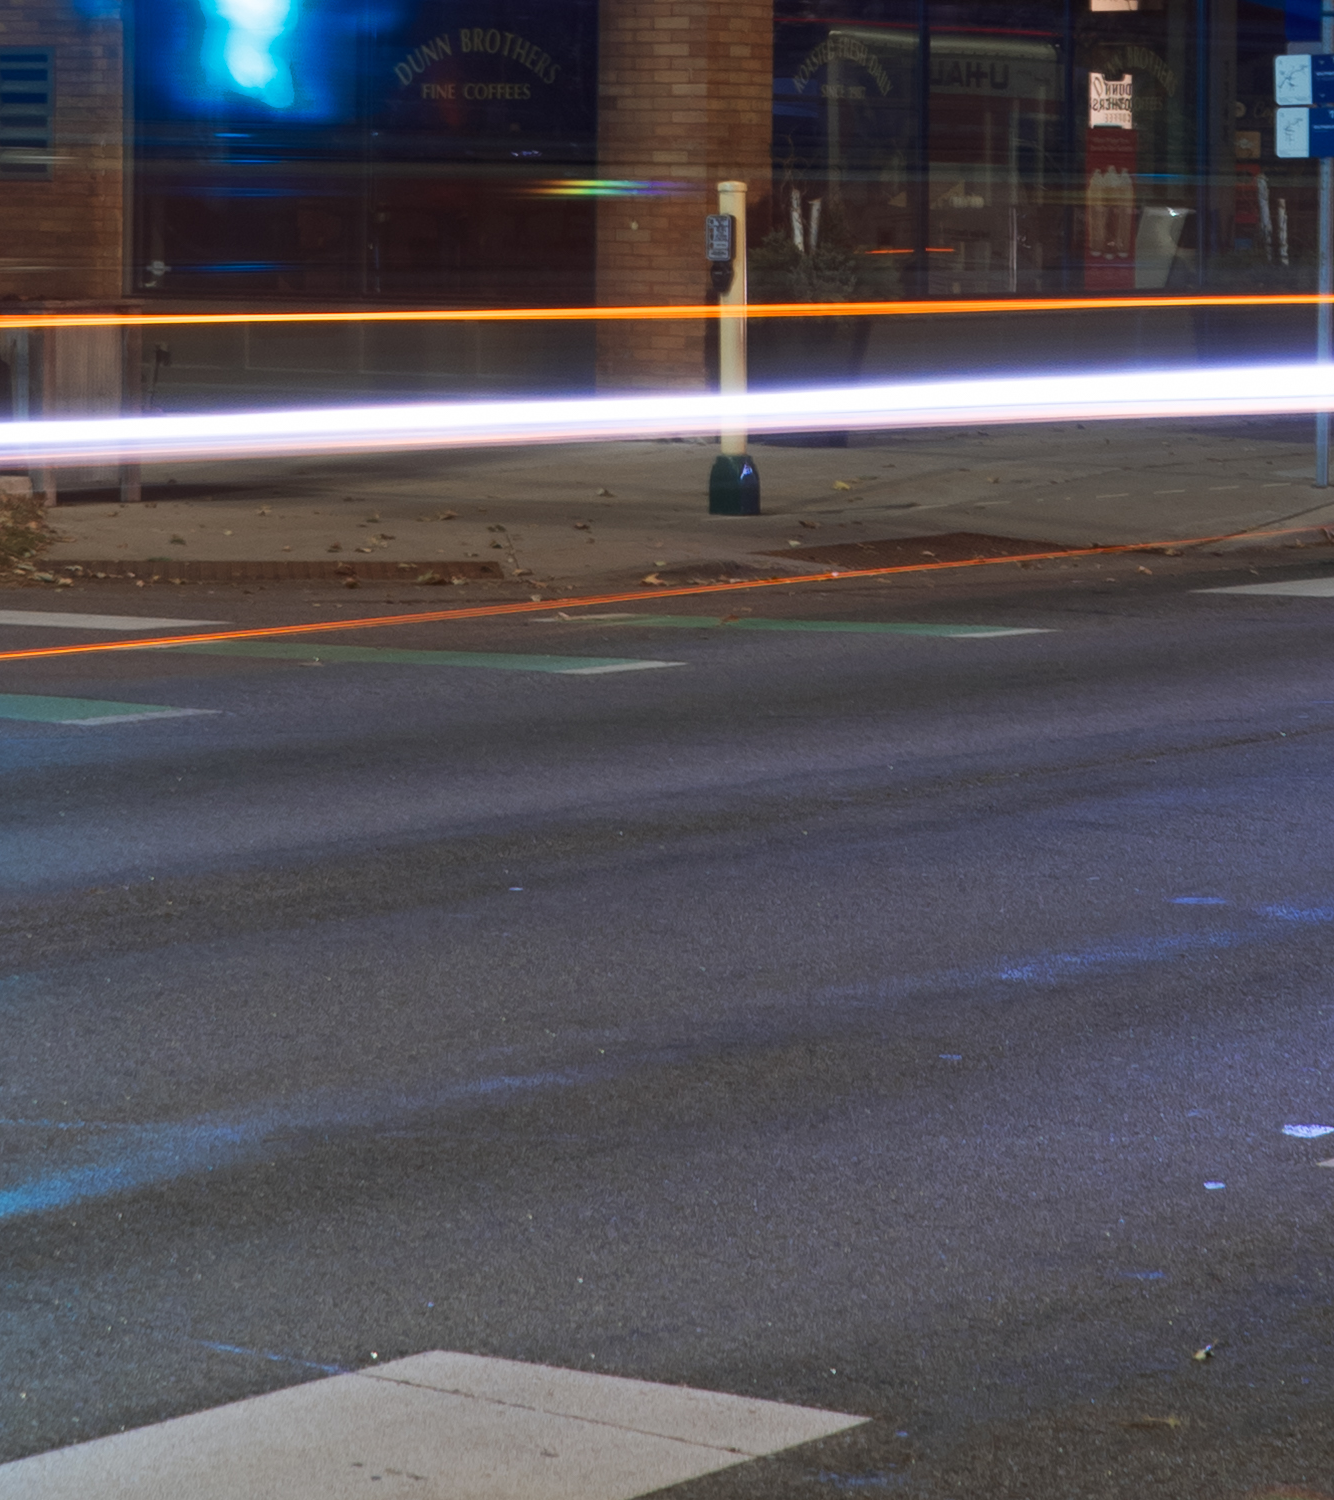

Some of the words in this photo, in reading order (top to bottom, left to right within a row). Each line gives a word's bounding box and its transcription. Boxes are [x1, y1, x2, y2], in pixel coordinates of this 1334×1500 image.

[393, 33, 453, 86] DUNN
[460, 27, 562, 85] BROTHERS
[421, 83, 456, 100] FINE
[463, 83, 531, 100] COFFEES
